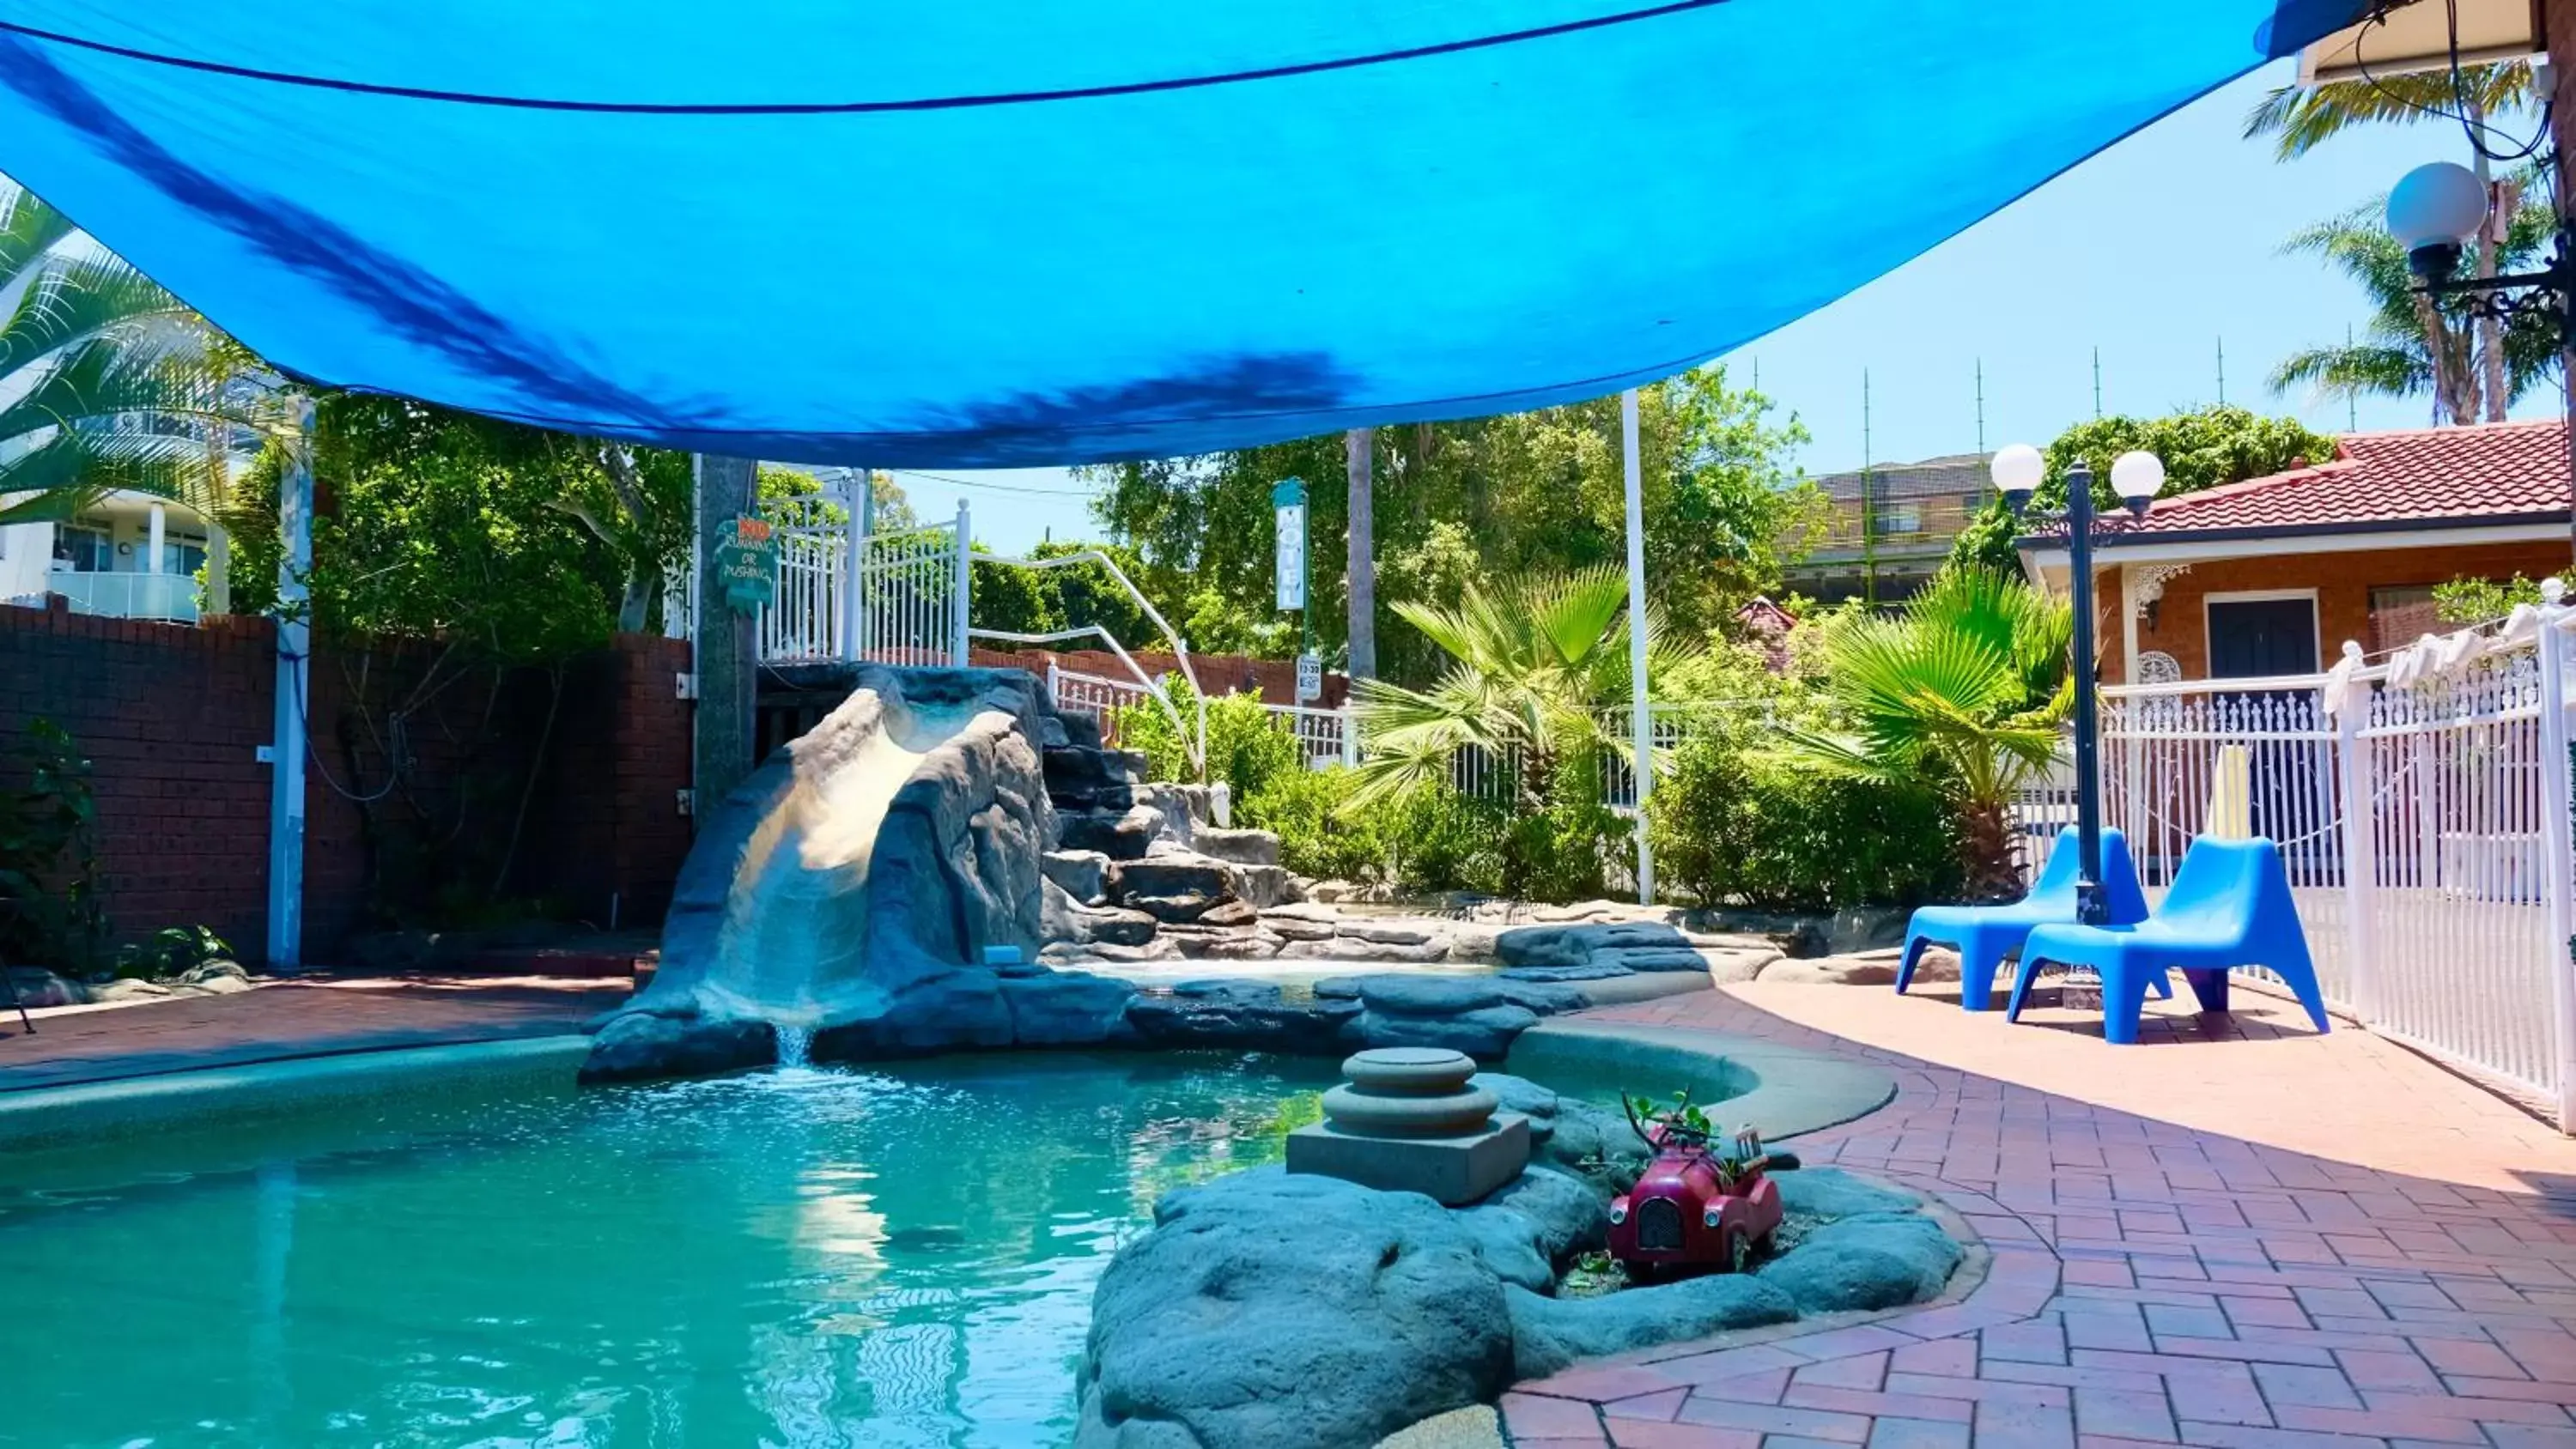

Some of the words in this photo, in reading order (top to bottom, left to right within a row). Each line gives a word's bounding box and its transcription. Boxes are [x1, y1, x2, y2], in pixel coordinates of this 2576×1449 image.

[738, 518, 770, 541] NO
[741, 552, 756, 566] OR
[1278, 507, 1302, 607] MOTEL
